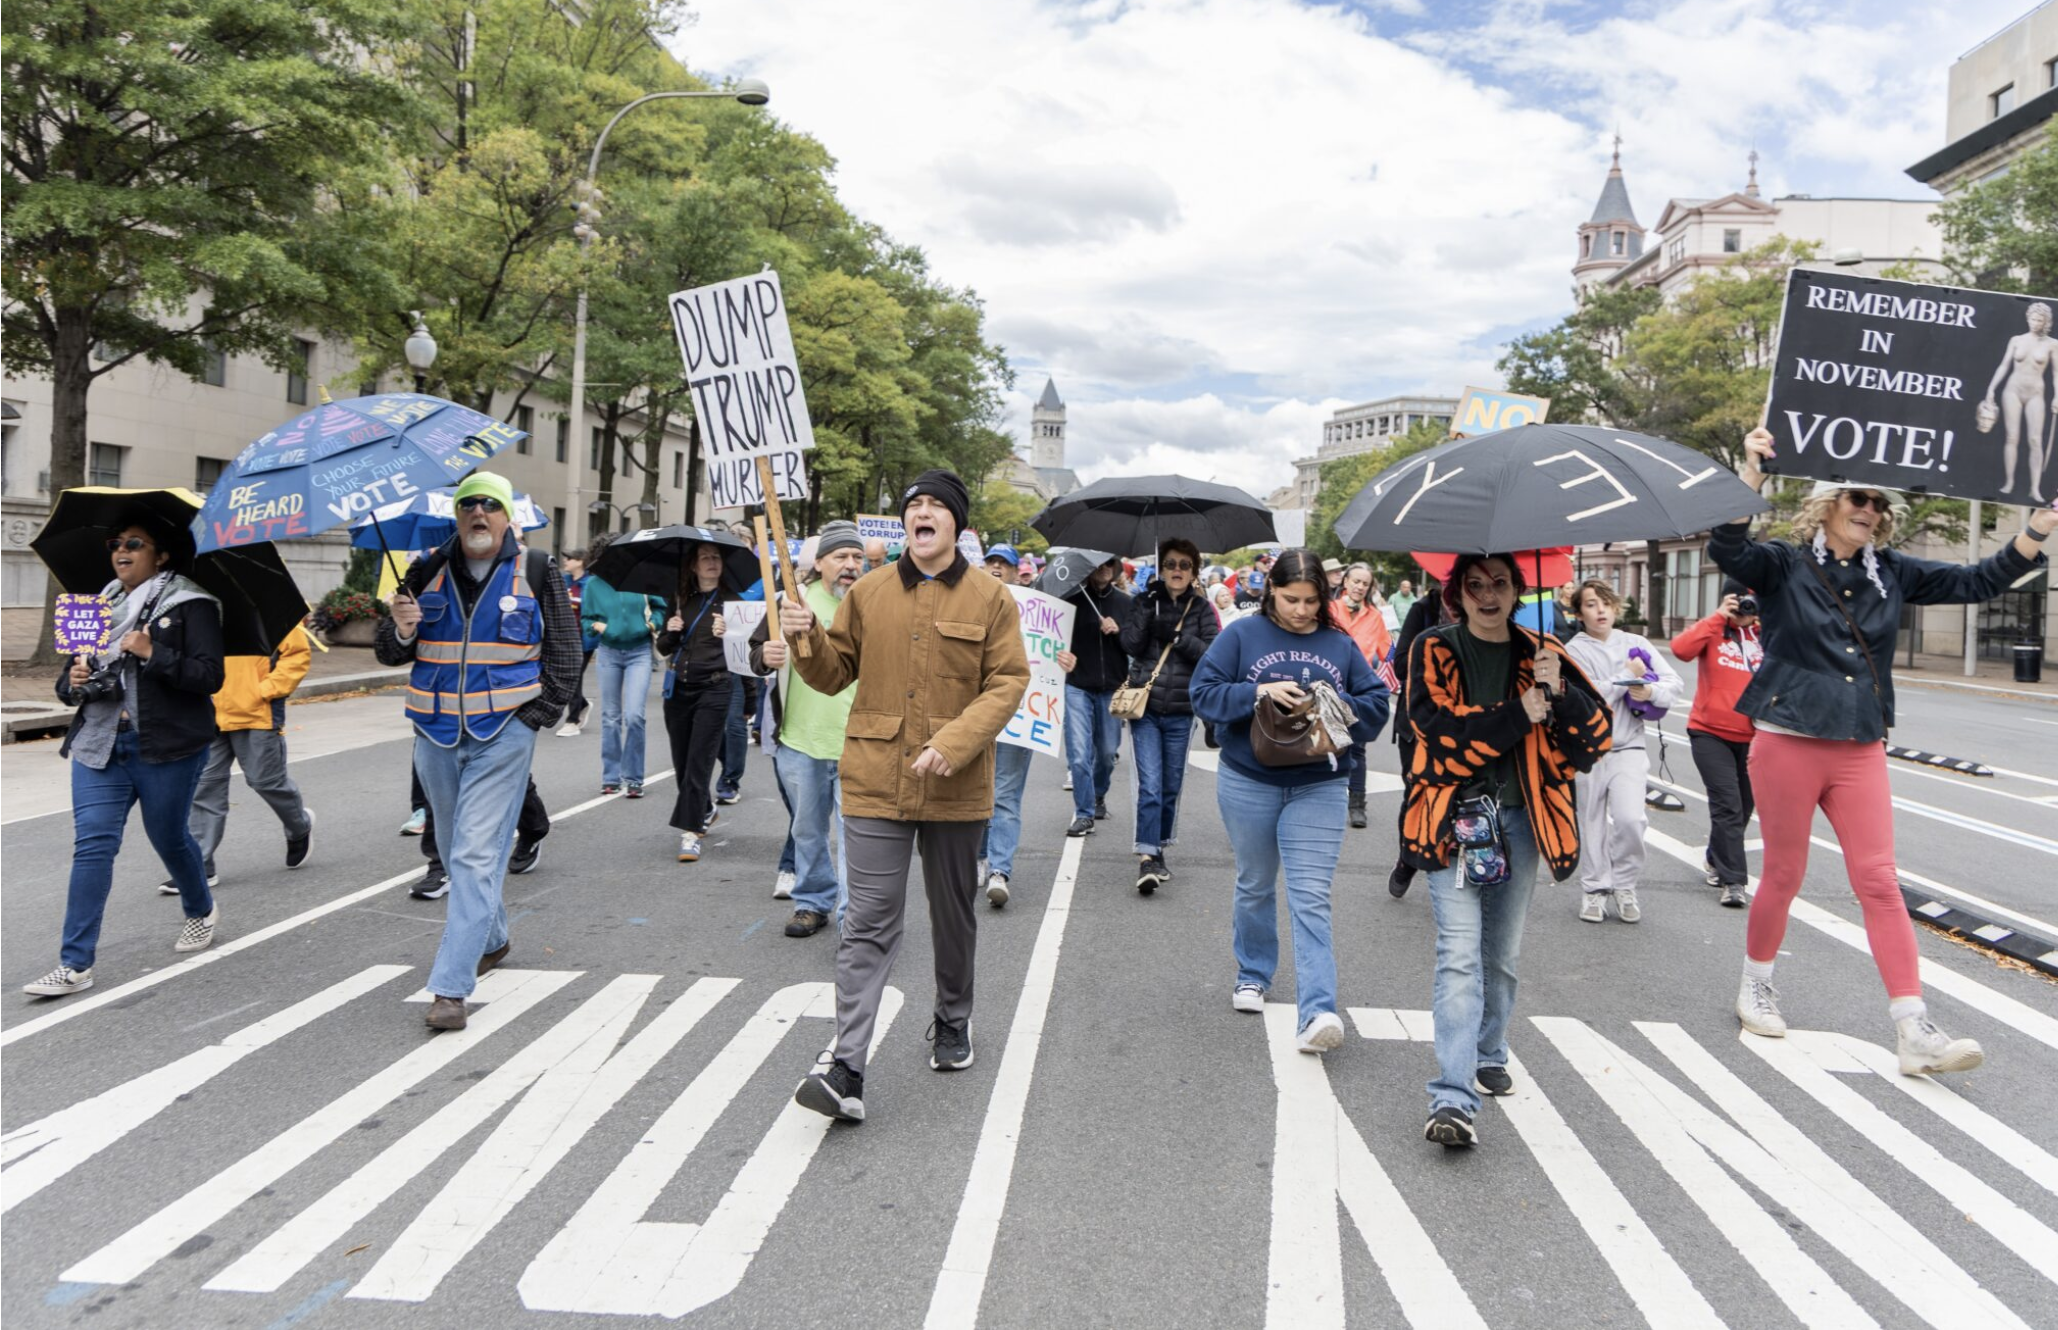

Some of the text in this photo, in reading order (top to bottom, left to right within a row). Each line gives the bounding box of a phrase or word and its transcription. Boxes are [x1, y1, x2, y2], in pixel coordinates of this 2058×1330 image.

[1806, 286, 1977, 328] REMEMBER
[674, 280, 778, 373] DUMP
[1859, 329, 1895, 354] IN
[1794, 358, 1964, 401] NOVEMBER
[690, 365, 797, 455] TRUMP
[1464, 397, 1534, 430] NO
[1784, 410, 1954, 473] VOTE!
[311, 454, 375, 488] CHOOSE
[324, 451, 422, 500] YOUR FUTURE
[228, 481, 266, 510] BE
[235, 493, 303, 527] HEARD
[327, 472, 420, 522] VOTE
[213, 511, 308, 547] VOTE
[859, 519, 904, 530] VOTE! EN
[860, 529, 905, 540] CORRUP
[67, 620, 100, 630] GAZA
[74, 610, 95, 619] LET
[729, 605, 767, 625] ACH
[70, 631, 97, 641] LIVE
[1026, 633, 1066, 662] TCH
[1246, 651, 1344, 694] LIGHT READING
[1004, 714, 1052, 747] CE
